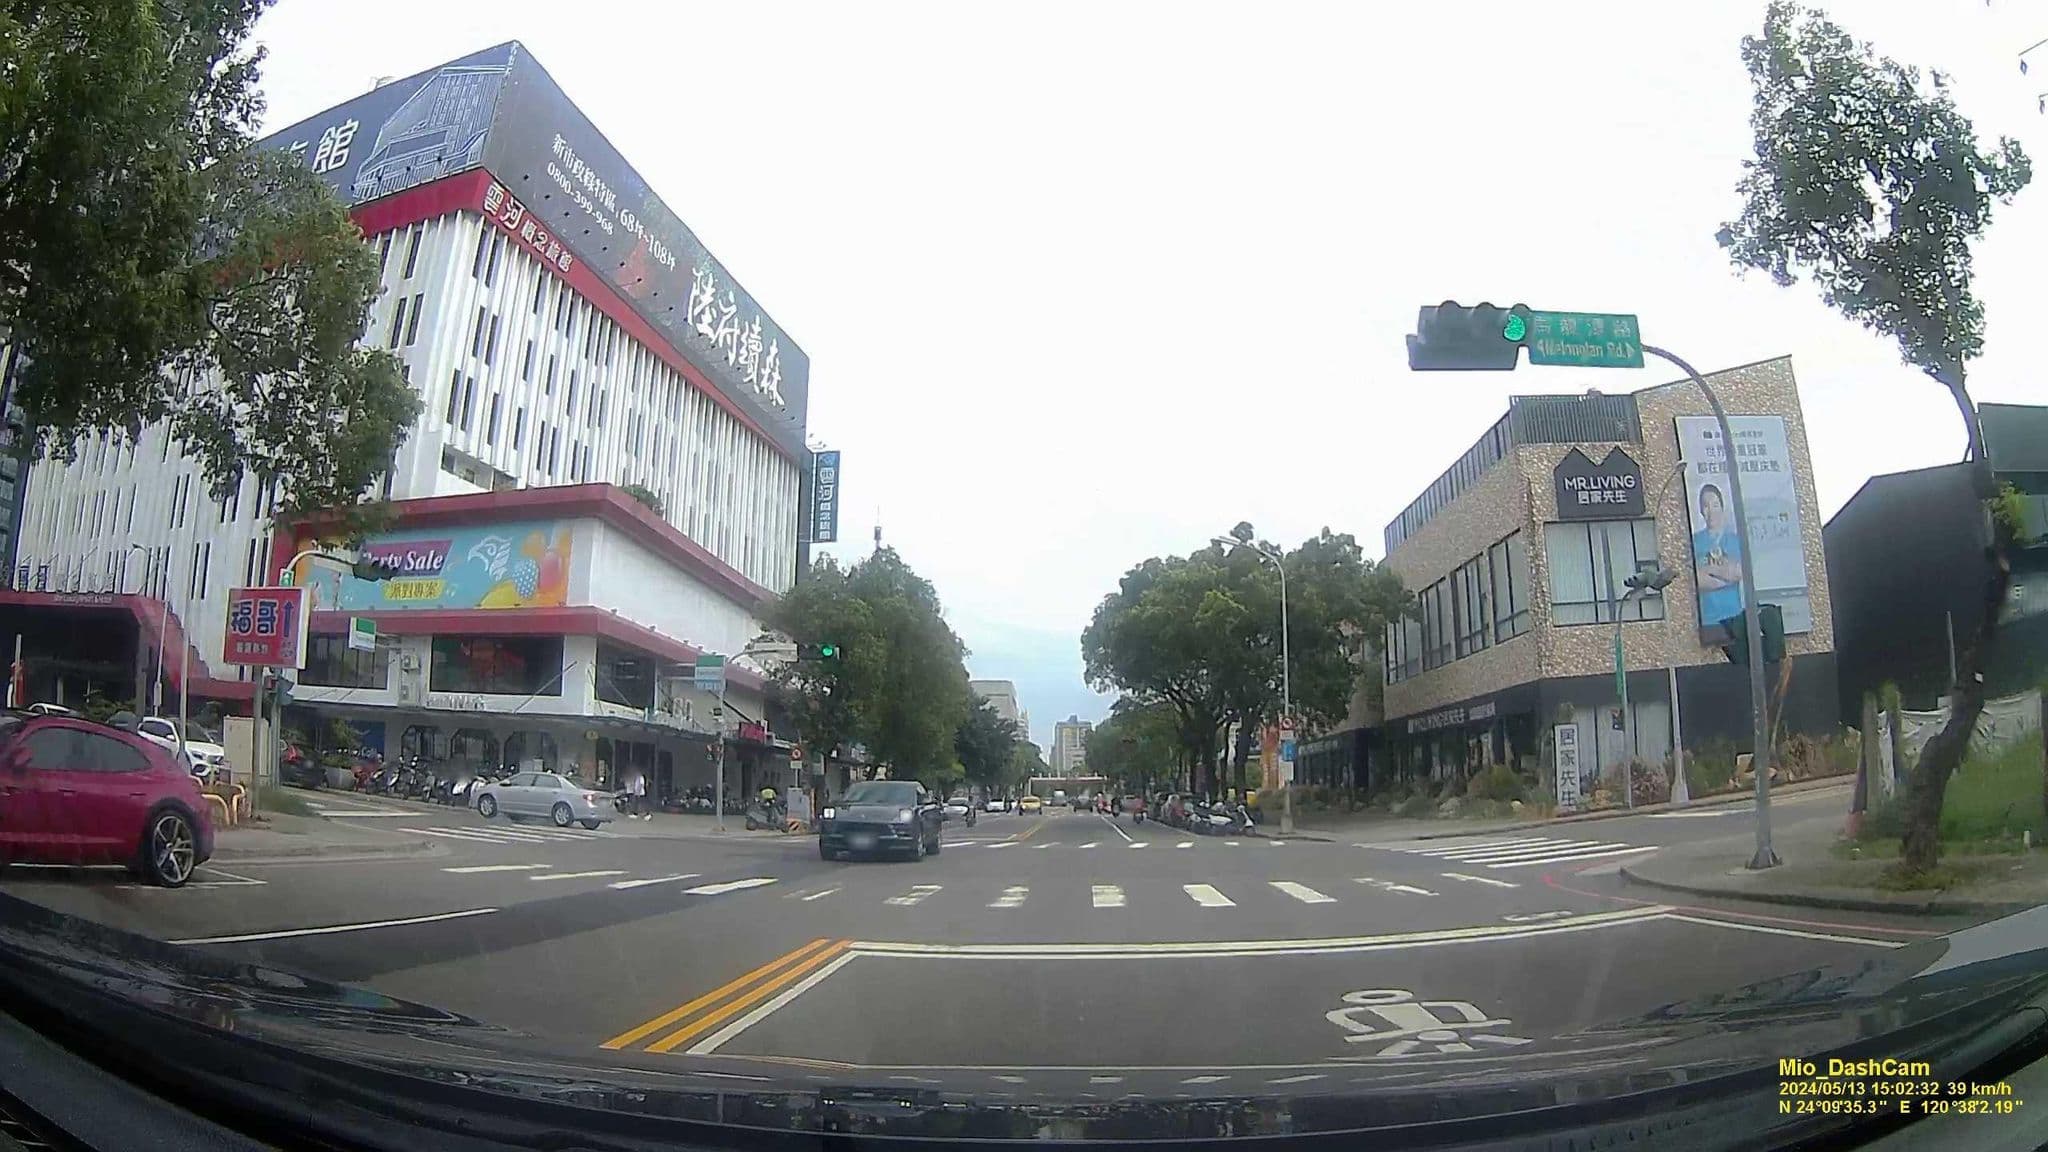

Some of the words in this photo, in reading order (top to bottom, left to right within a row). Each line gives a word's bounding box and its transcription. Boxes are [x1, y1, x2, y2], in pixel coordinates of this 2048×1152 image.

[547, 161, 614, 236] 0800-399-968
[1563, 475, 1636, 491] MR.LIVING
[1578, 490, 1628, 504] 居家先生
[404, 550, 443, 571] Sale
[230, 600, 279, 634] 福哥
[1559, 728, 1577, 807] 居家先生
